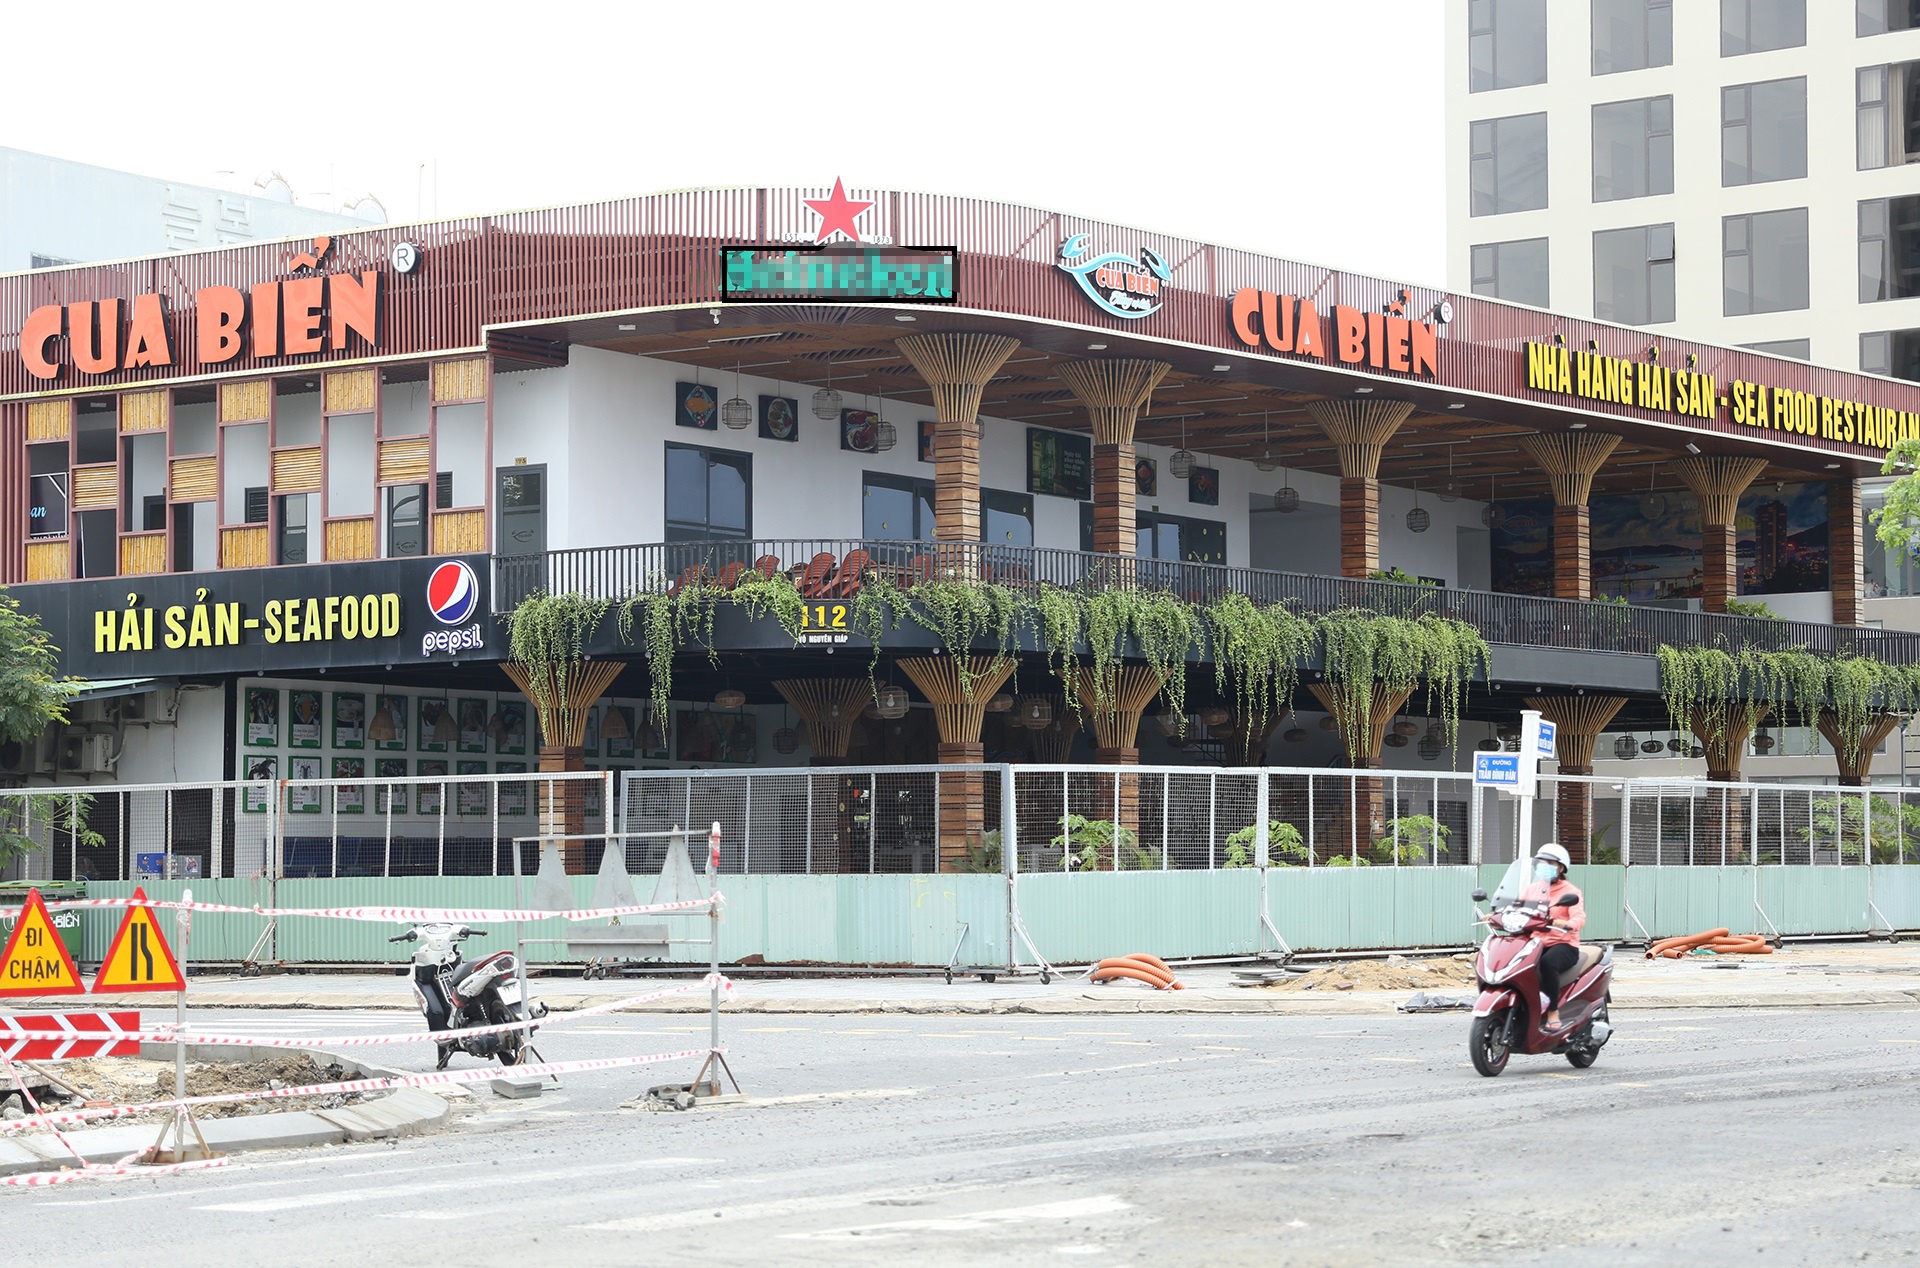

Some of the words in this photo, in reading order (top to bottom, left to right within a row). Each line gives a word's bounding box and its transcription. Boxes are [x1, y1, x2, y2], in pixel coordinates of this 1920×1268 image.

[1095, 267, 1125, 291] CUA
[1126, 267, 1160, 298] BIỂN
[21, 293, 173, 380] CUA
[196, 236, 378, 364] BIỂN
[1231, 287, 1324, 358] CUA
[1335, 288, 1438, 378] BIỂN
[1527, 334, 1572, 395] NHÀ
[1577, 340, 1633, 406] HÀNG
[1637, 346, 1671, 412] HẢI
[1675, 353, 1716, 419] SẢN
[1732, 379, 1769, 428] SEA
[1773, 387, 1818, 436] FOOD
[94, 591, 154, 654] HẢI
[422, 623, 484, 657] pepsi
[1491, 759, 1512, 767] ĐƯỜNG
[25, 927, 43, 947] ĐI
[9, 955, 60, 983] CHẬM
